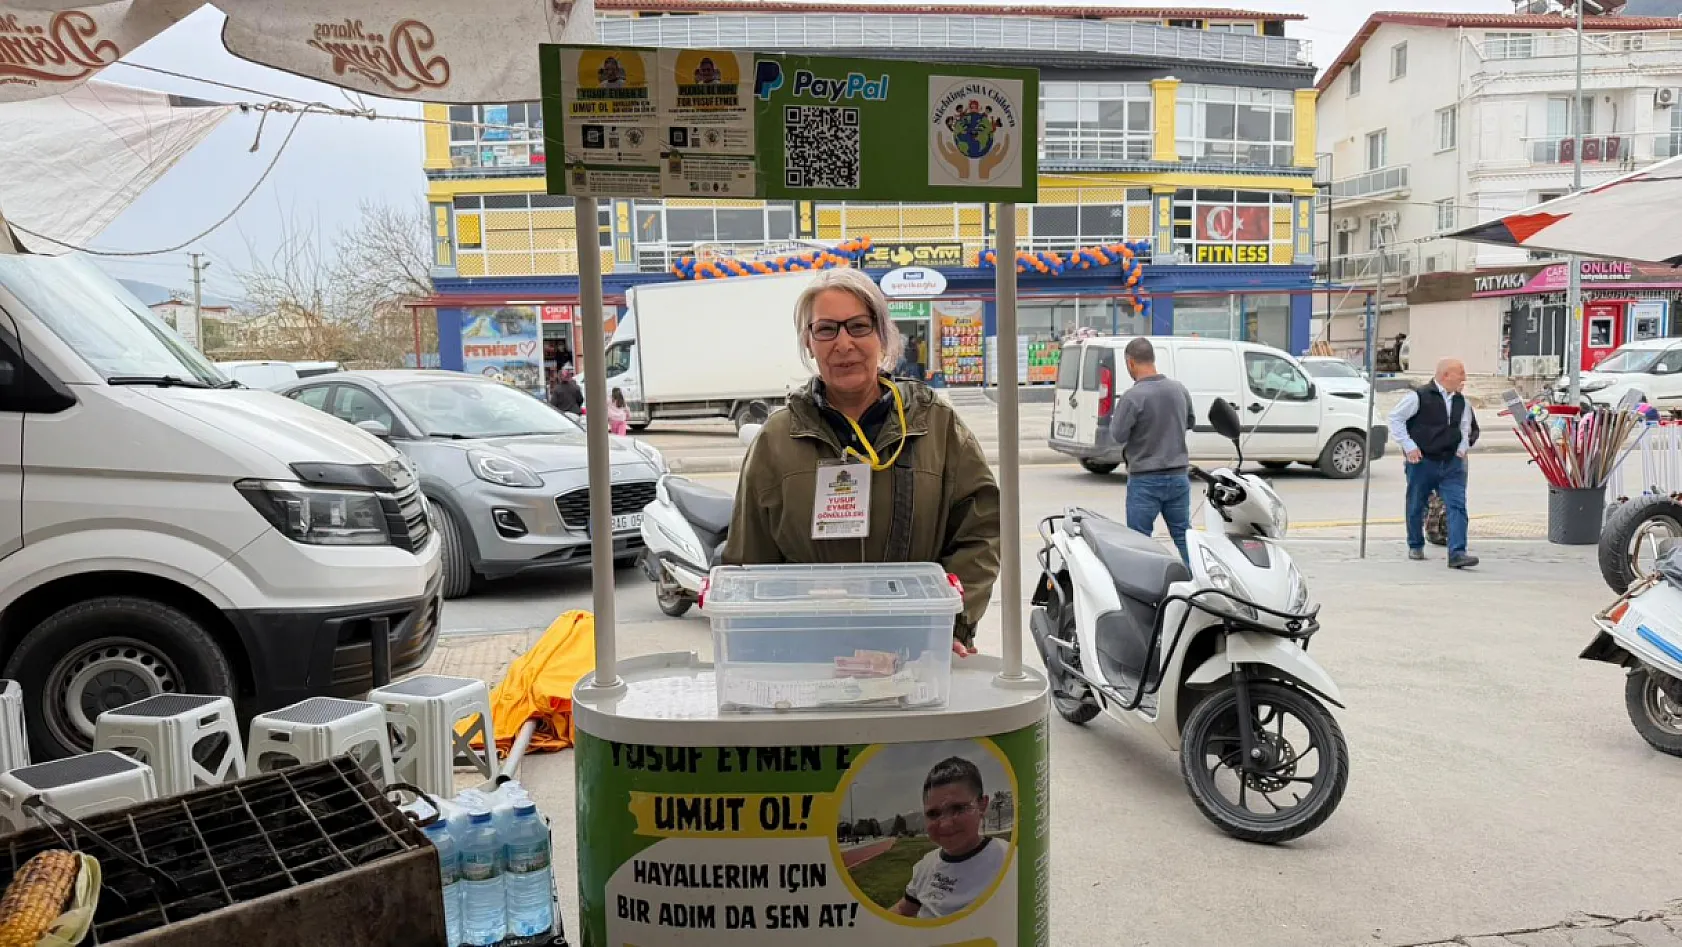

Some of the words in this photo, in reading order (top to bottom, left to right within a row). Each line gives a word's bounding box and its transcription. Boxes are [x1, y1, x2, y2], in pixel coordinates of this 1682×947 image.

[793, 69, 890, 103] PayPal
[573, 102, 596, 113] UMUT
[598, 102, 609, 112] OL
[933, 87, 966, 125] Stichting
[966, 84, 986, 95] SMA
[988, 89, 1015, 127] Children
[914, 246, 960, 259] GYM
[1198, 246, 1267, 262] FITNESS
[1474, 273, 1526, 291] TATYAKA
[826, 503, 856, 511] EYMEN
[828, 496, 856, 504] YUSUF
[610, 741, 703, 773] YUSUF
[717, 745, 823, 773] EYMEN
[654, 796, 745, 831] UMUT
[759, 794, 813, 831] OL!
[725, 905, 757, 929] DA
[766, 905, 809, 929] SEN
[819, 902, 859, 928] AT!
